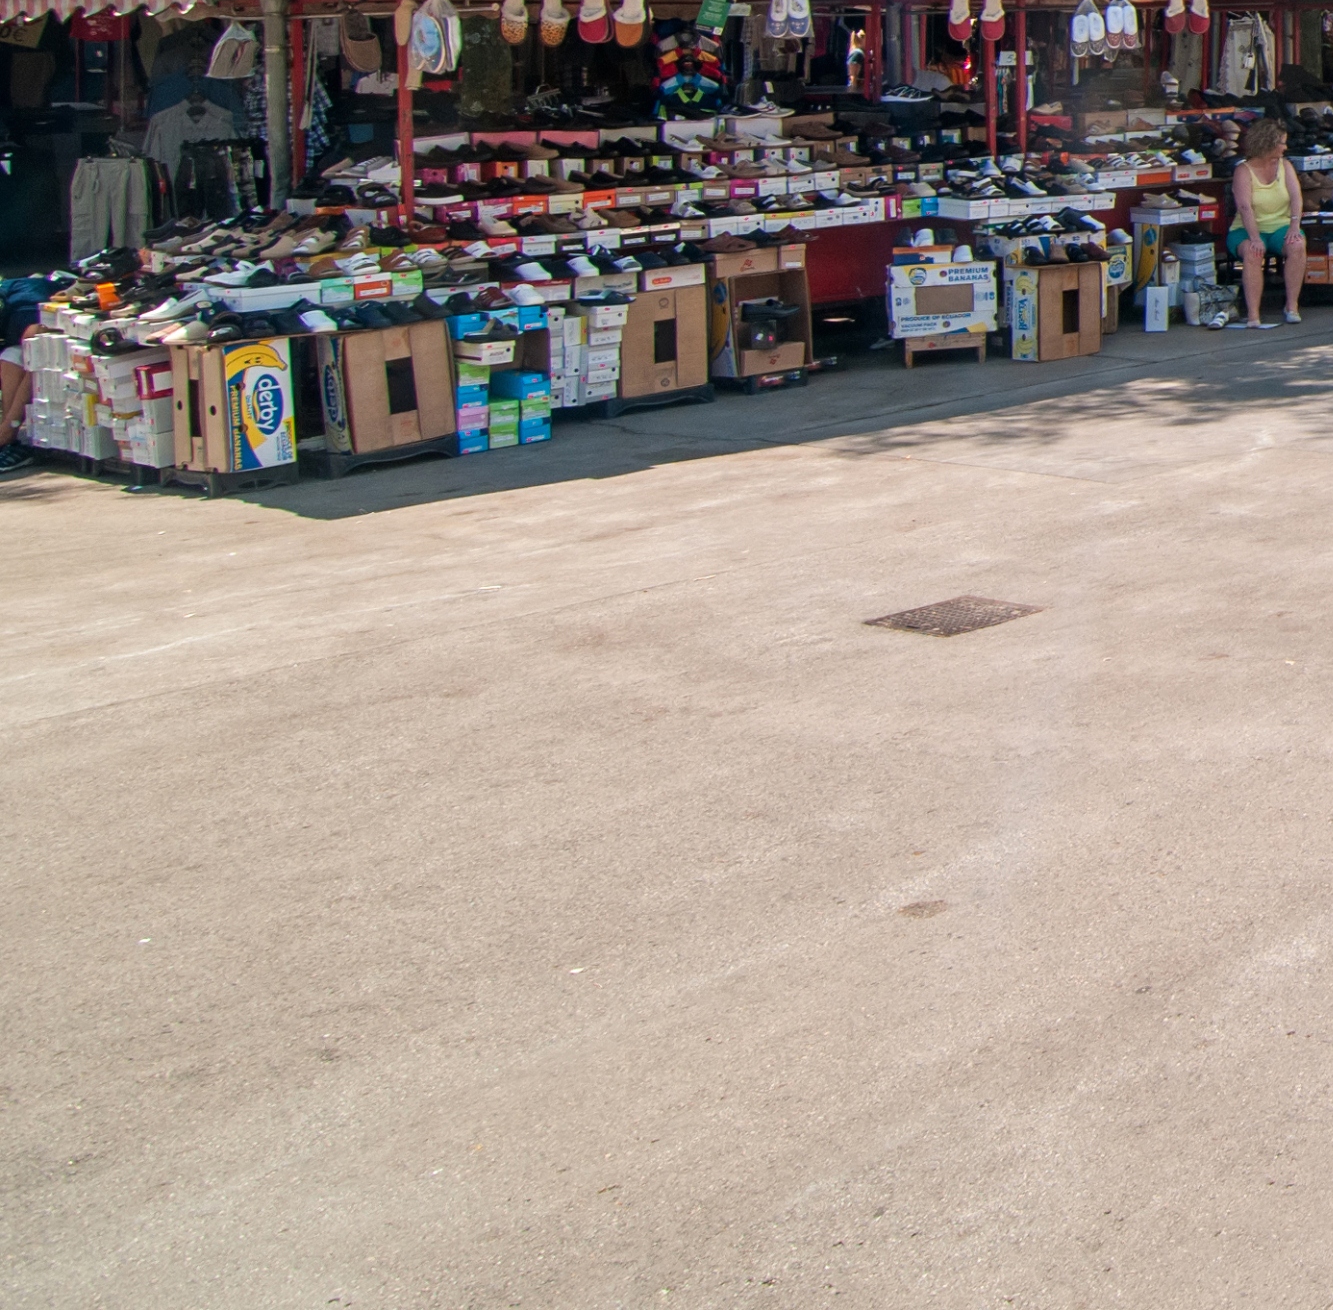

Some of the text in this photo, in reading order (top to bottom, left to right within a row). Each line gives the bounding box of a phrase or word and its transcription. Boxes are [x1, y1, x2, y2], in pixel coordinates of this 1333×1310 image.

[948, 267, 989, 275] PREMIUM
[948, 274, 989, 282] BANANAS
[941, 312, 972, 320] ECUADOR
[230, 385, 241, 427] PREMIUM
[256, 378, 281, 430] derby
[233, 428, 243, 470] BANANAS
